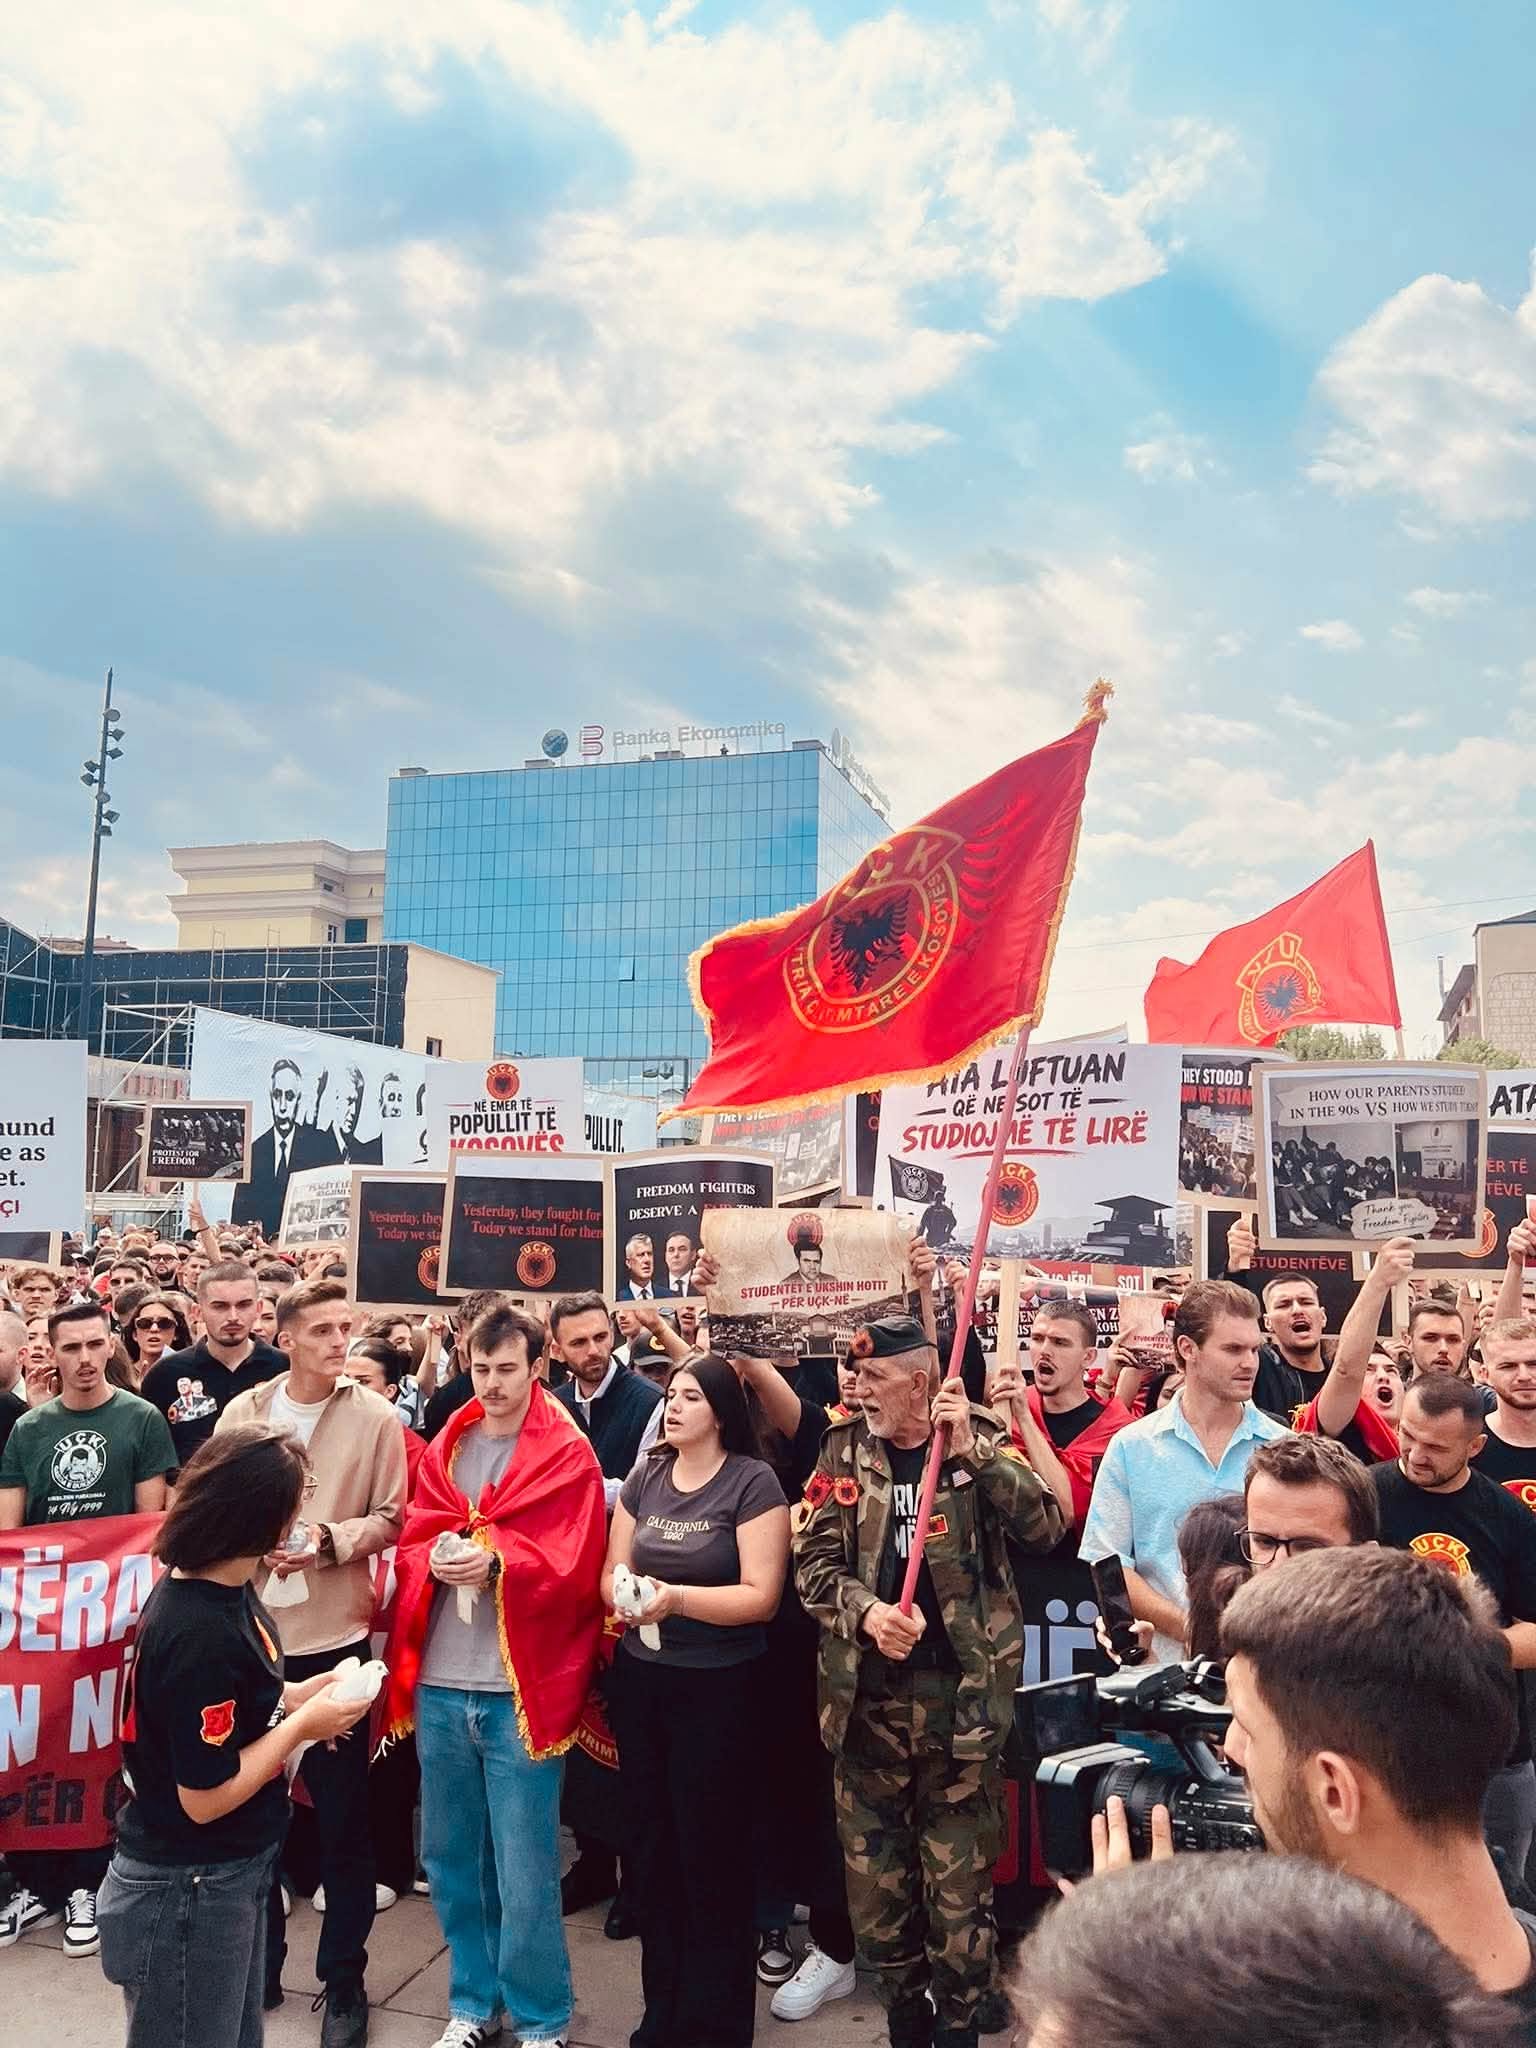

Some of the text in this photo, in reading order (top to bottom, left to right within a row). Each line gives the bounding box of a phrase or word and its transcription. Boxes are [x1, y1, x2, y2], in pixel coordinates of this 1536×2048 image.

[613, 720, 785, 746] Banka Ekonomike
[1203, 1068, 1244, 1086] STOOD
[953, 1094, 977, 1117] QË
[1016, 1091, 1054, 1112] SOT
[1060, 1087, 1084, 1109] TË
[1309, 1089, 1342, 1102] HOW
[1345, 1087, 1374, 1099] OUR
[1377, 1085, 1430, 1098] PARENTS
[1290, 1108, 1305, 1120] IN
[1307, 1105, 1336, 1118] THE
[1338, 1106, 1360, 1116] 90s
[1365, 1102, 1388, 1117] VS
[1393, 1101, 1418, 1113] HOW
[1420, 1102, 1434, 1112] WE
[450, 1106, 557, 1135] POPULLIT TË
[1044, 1112, 1078, 1146] TË
[1087, 1110, 1149, 1146] LIRË
[19, 1147, 45, 1161] as
[152, 1156, 195, 1166] FREEDOM
[1510, 1157, 1528, 1175] TË
[636, 1181, 756, 1199] FREEDOM FIGHTERS
[368, 1211, 419, 1226] Yesterday,
[463, 1203, 601, 1223] Yesterday, they fought for
[629, 1204, 682, 1221] DESERVE
[688, 1206, 698, 1216] A
[377, 1227, 409, 1243] Today
[410, 1231, 425, 1240] we
[472, 1220, 506, 1238] Today
[509, 1226, 524, 1234] we
[526, 1224, 557, 1237] stand
[560, 1224, 577, 1237] for
[1250, 1255, 1347, 1271] STUDENTËVE
[806, 1283, 813, 1293] E
[815, 1280, 855, 1293] UKSHIN
[857, 1280, 888, 1292] HOTIT
[646, 1515, 711, 1533] CALIFORNIA
